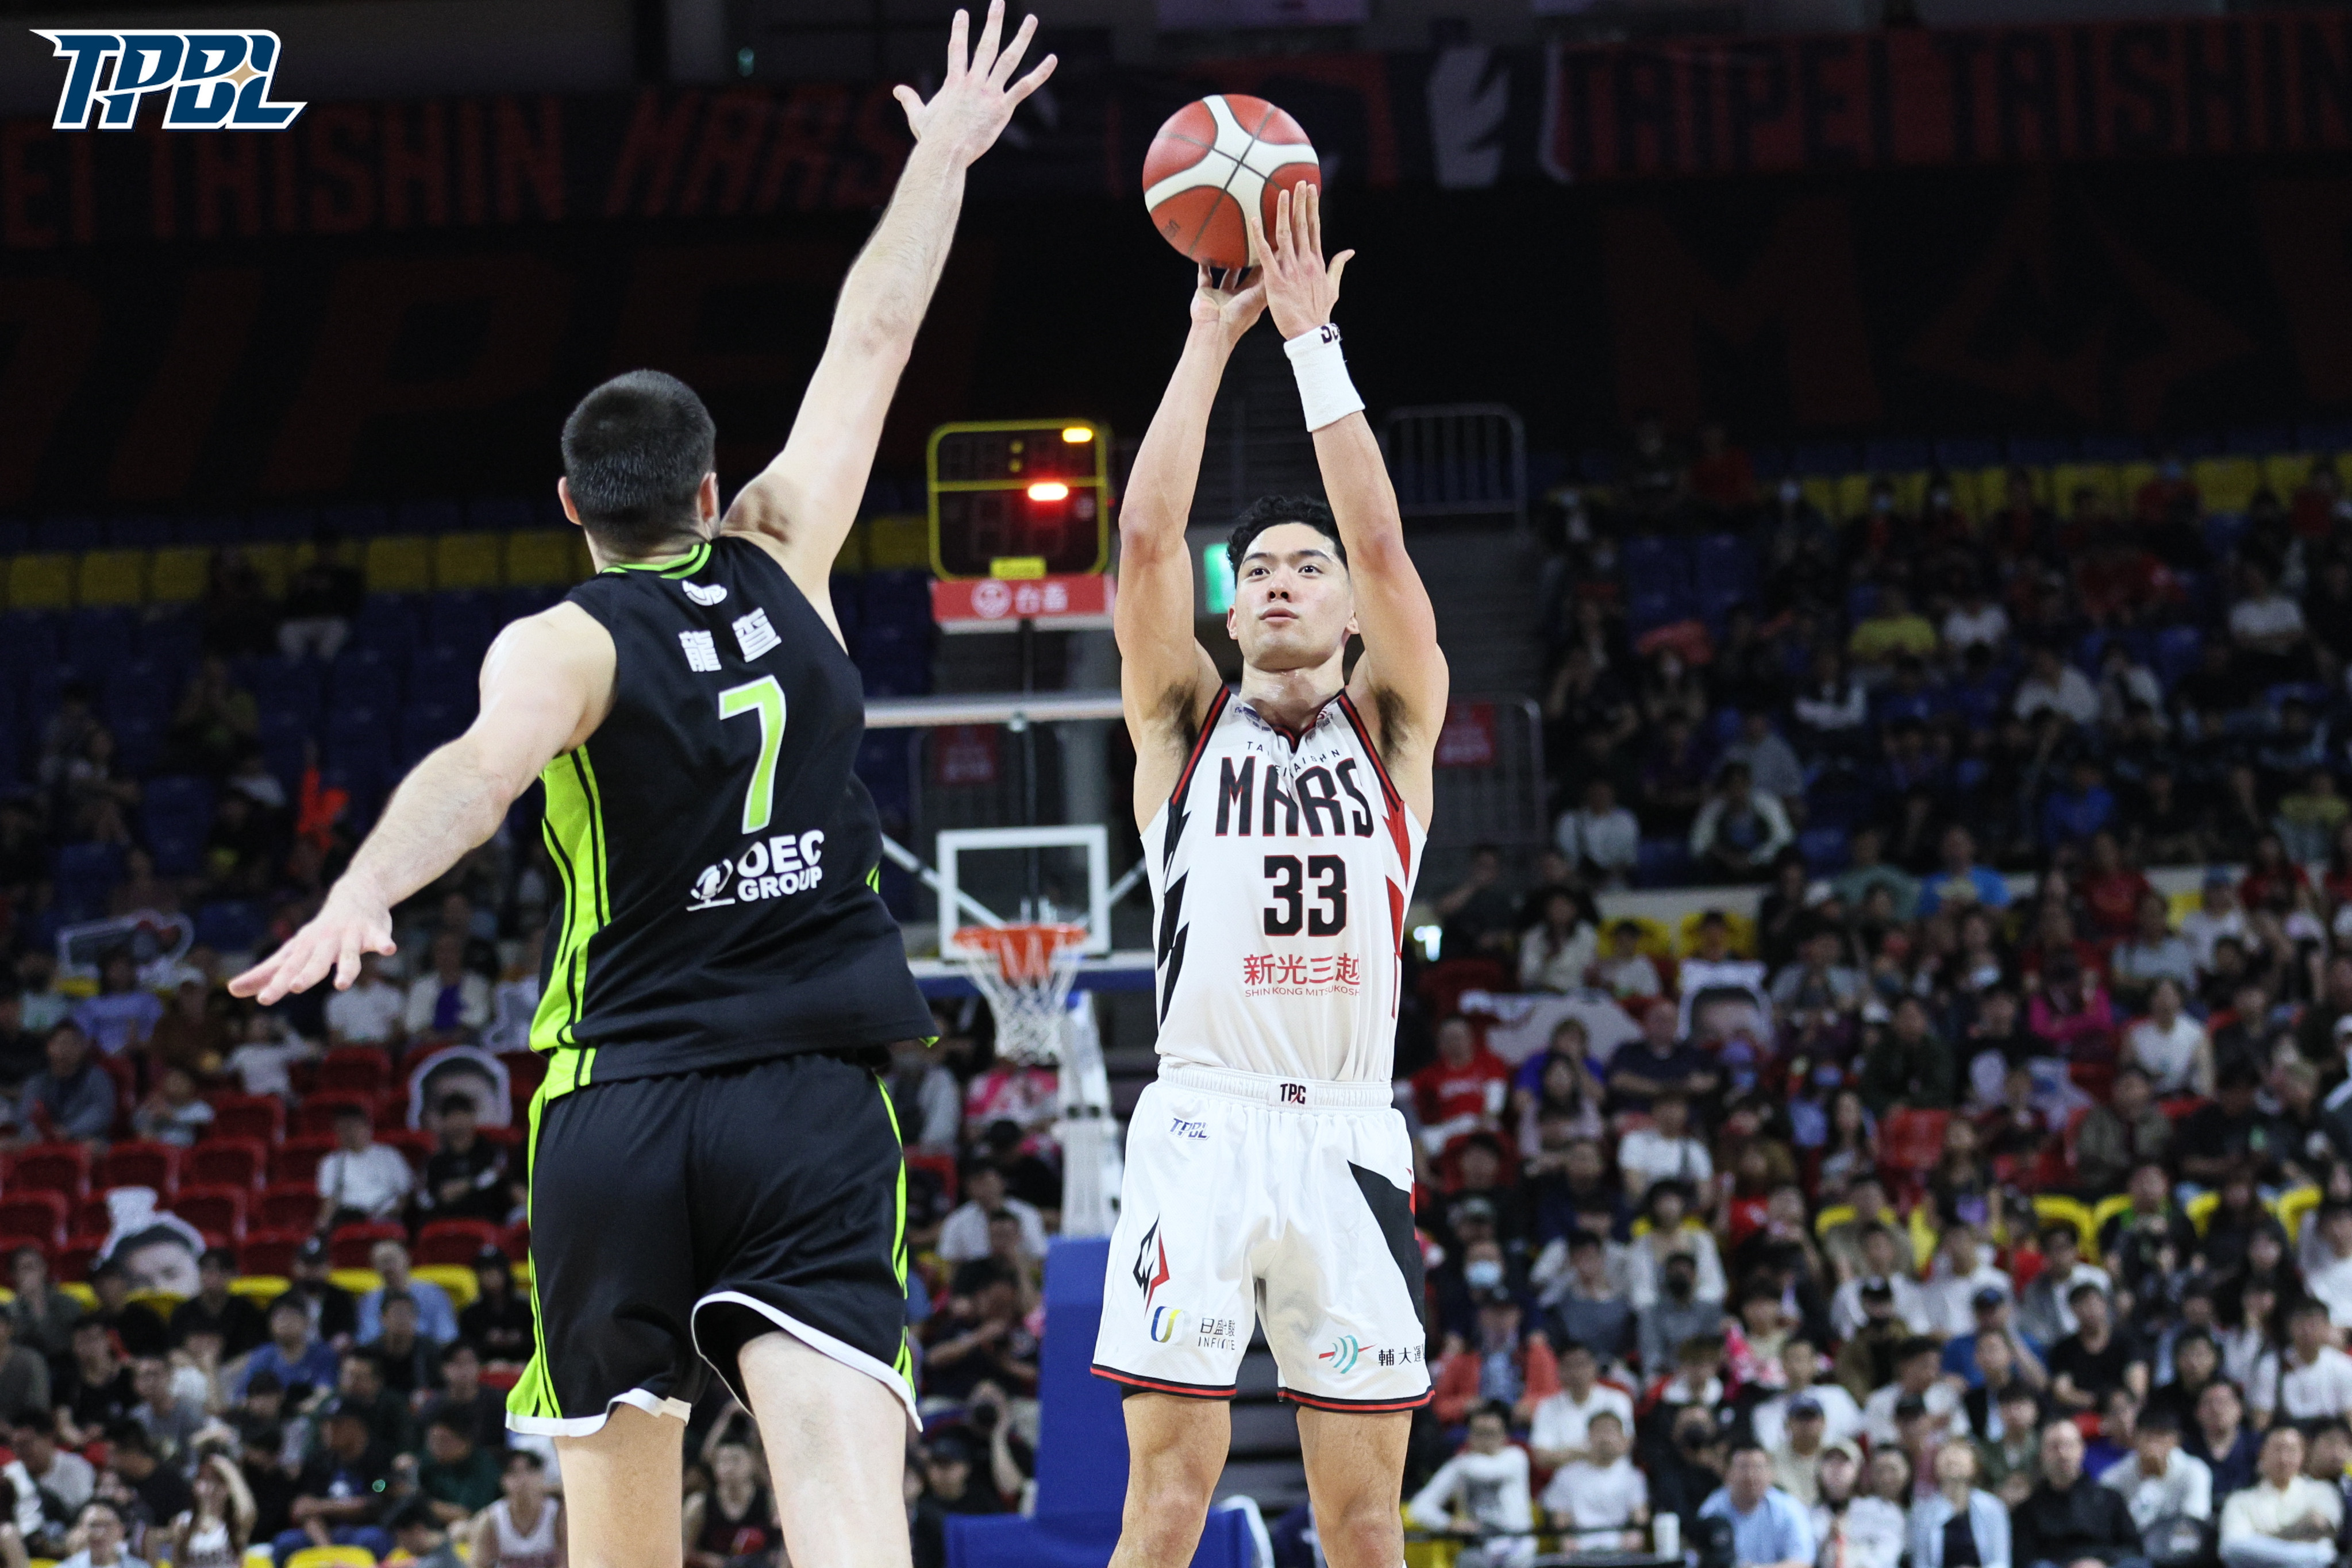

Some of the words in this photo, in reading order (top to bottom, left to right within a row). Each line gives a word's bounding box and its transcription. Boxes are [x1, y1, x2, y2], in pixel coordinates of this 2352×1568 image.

[718, 674, 787, 834] 7
[1215, 756, 1375, 838] MARS
[737, 829, 825, 879] OEC
[737, 865, 823, 902] GROUP
[1264, 854, 1347, 937] 33
[1244, 952, 1360, 986] 新光三越
[1245, 987, 1271, 997] SHIN
[1272, 986, 1303, 996] KONG
[1169, 1117, 1210, 1141] TPBL
[1378, 1343, 1425, 1366] 輔大運
